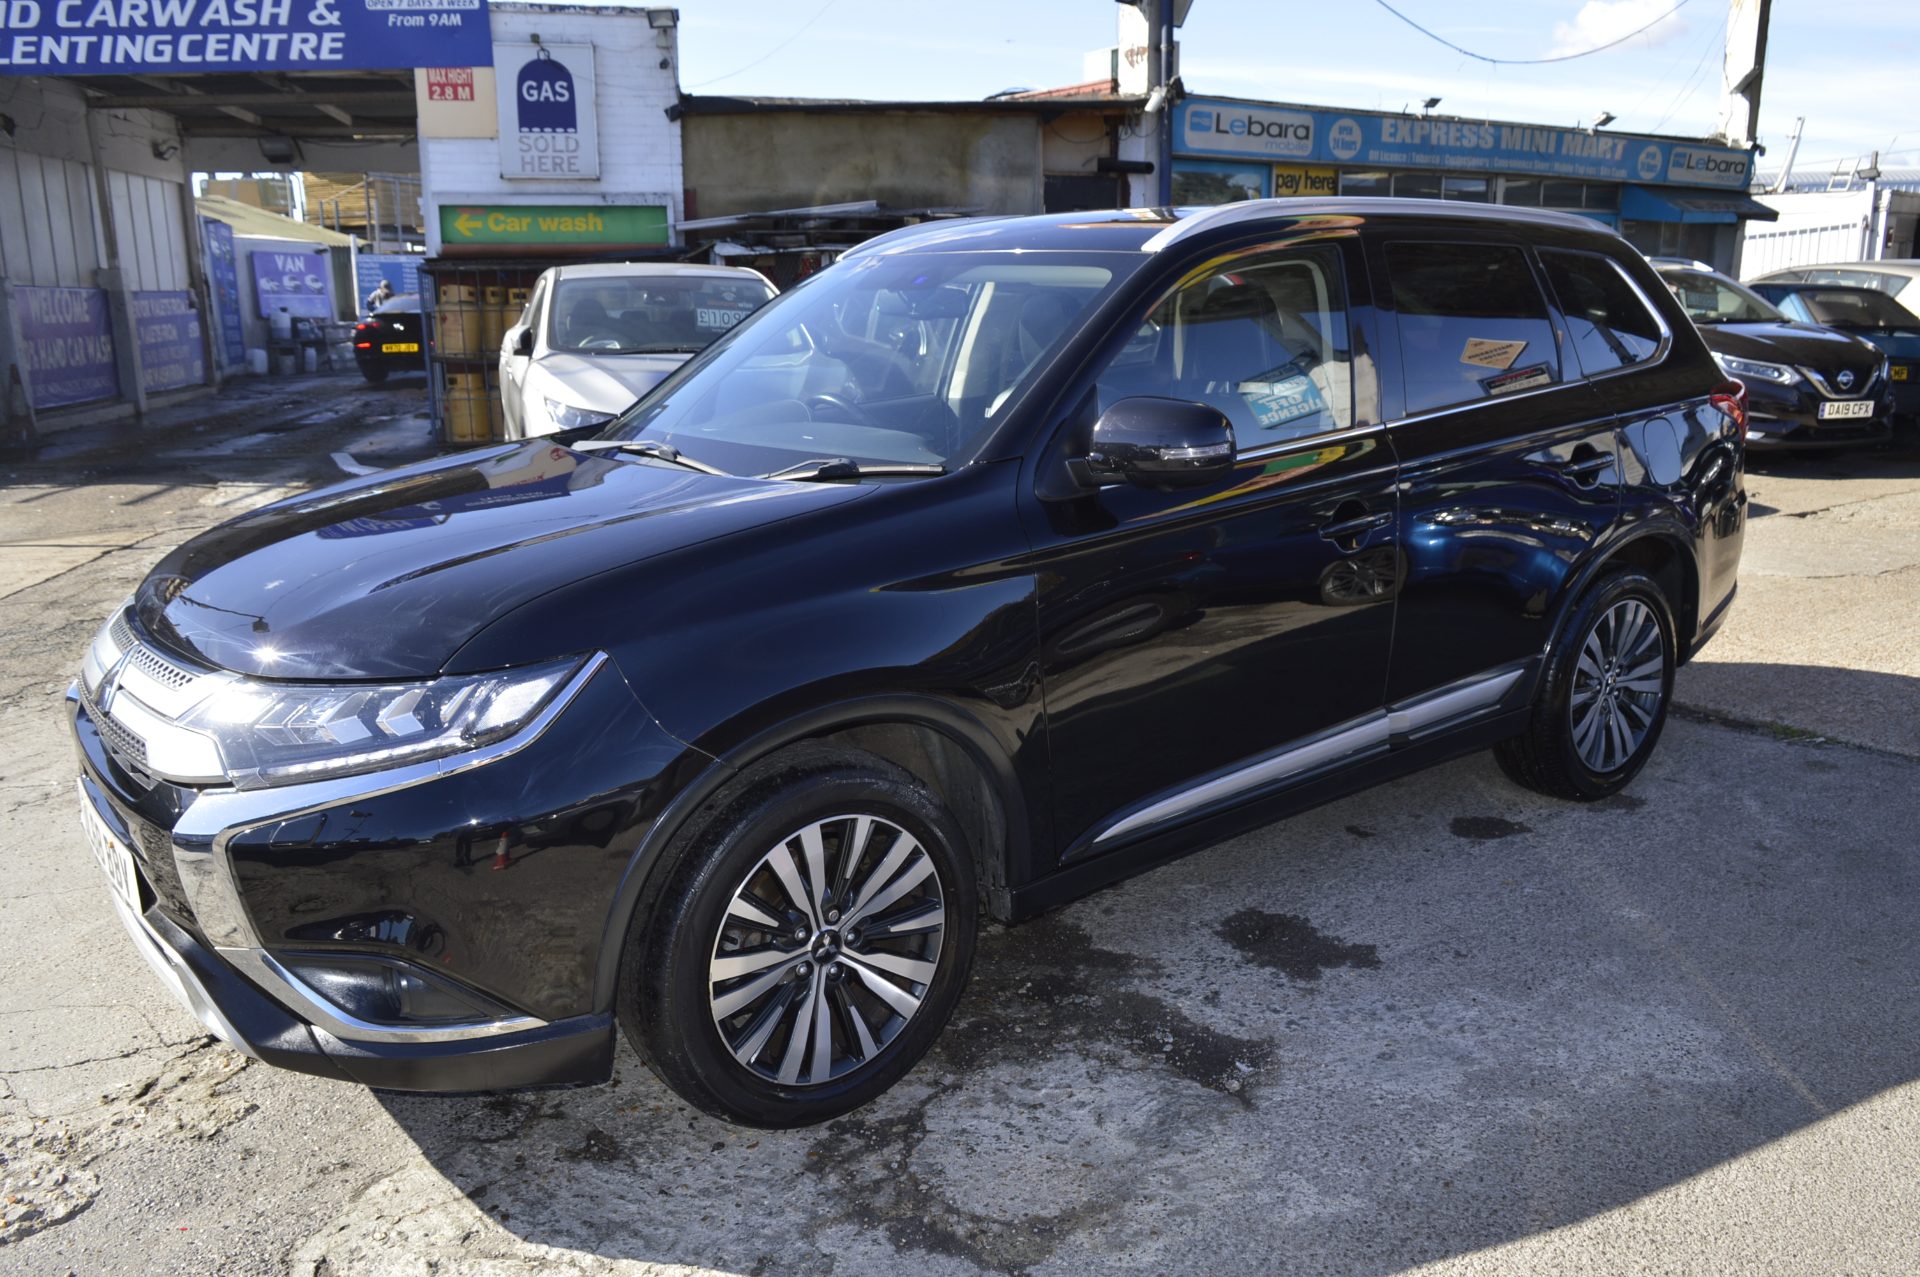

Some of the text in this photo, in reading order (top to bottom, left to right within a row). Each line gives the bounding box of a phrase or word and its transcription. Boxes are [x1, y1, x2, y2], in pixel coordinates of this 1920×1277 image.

[56, 0, 292, 28] CARWASH
[307, 0, 342, 26] &
[388, 13, 462, 27] From 9AM
[427, 67, 446, 84] MAX
[432, 86, 471, 99] 2.8 M
[521, 80, 570, 102] GAS
[1215, 112, 1310, 141] Lebara
[518, 135, 580, 153] SOLD
[1381, 118, 1628, 160] EXPRESS MINI MART
[520, 155, 580, 173] HERE
[1687, 153, 1745, 174] Lebara
[1276, 170, 1335, 194] pay here
[487, 212, 604, 232] Car wash
[274, 254, 304, 272] VAN
[26, 288, 90, 324] WELCOME
[40, 338, 66, 370] HAND
[68, 336, 87, 367] CAR
[87, 334, 113, 363] WASH
[1828, 404, 1850, 416] DA19
[1852, 403, 1871, 414] CFX
